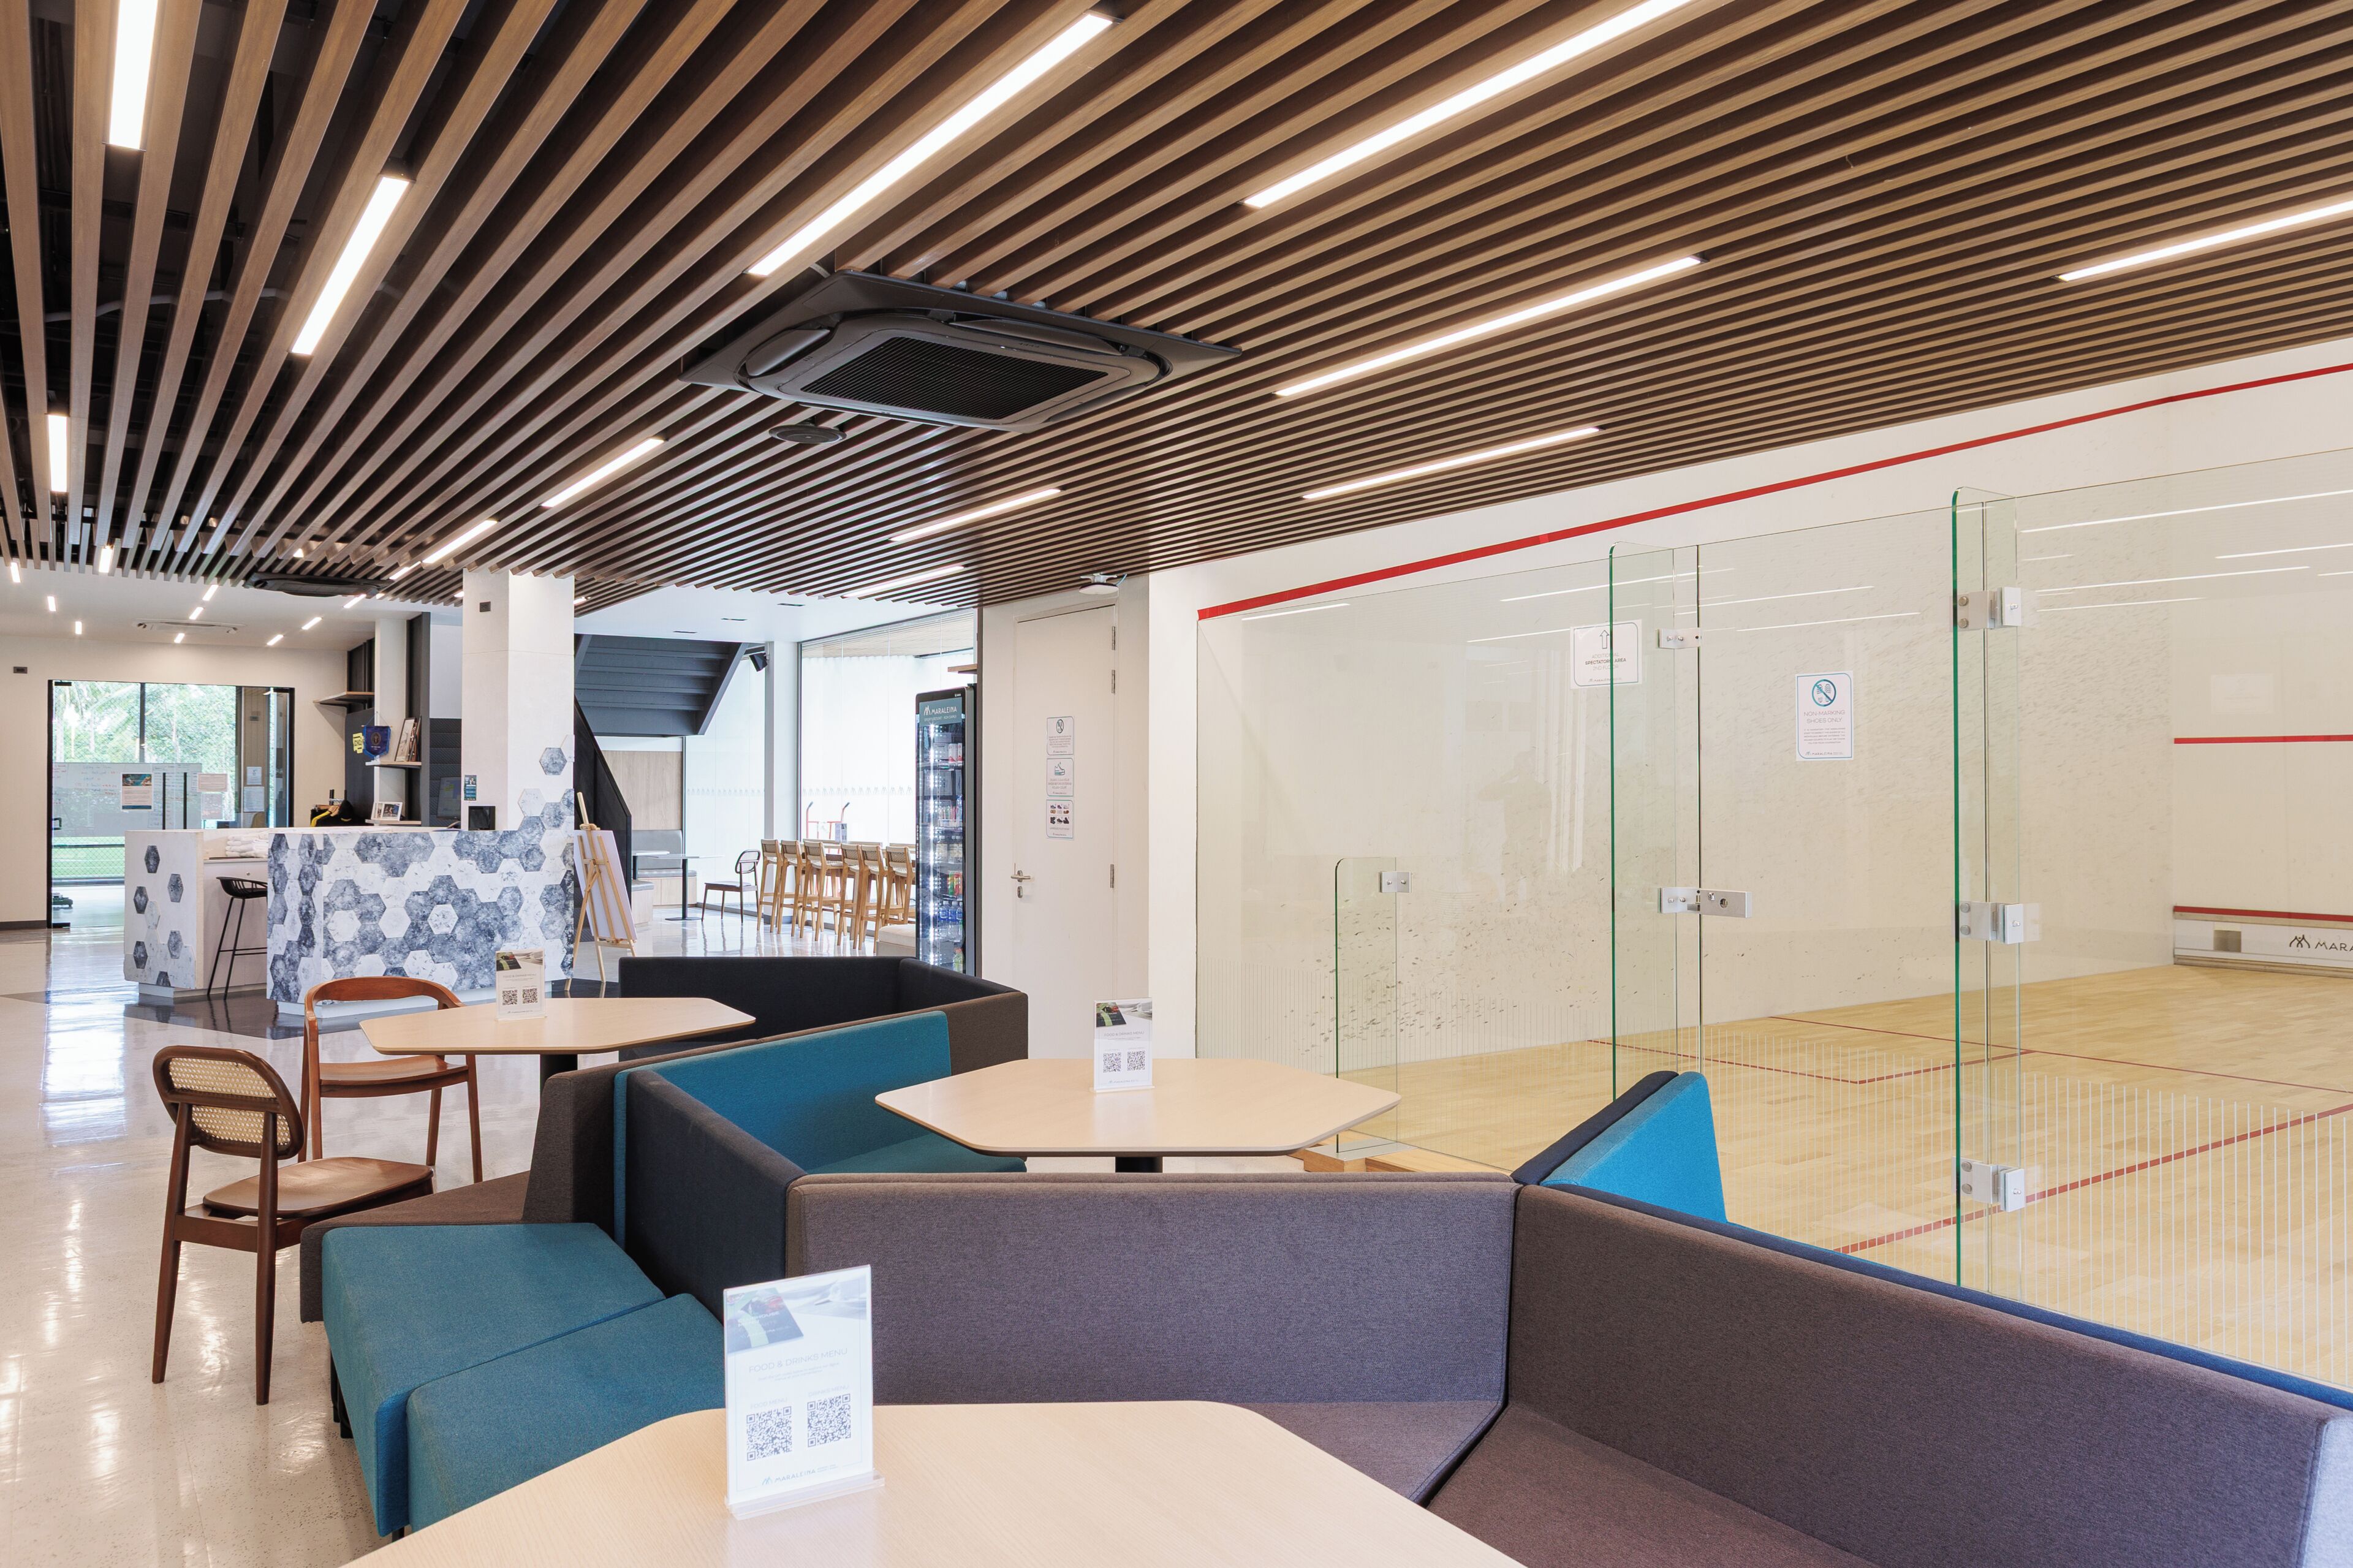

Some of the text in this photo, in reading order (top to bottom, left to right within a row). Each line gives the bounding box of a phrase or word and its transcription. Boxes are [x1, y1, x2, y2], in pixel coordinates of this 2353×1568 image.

[931, 706, 957, 715] MARALEINA
[749, 1362, 775, 1373] FOOD
[786, 1354, 819, 1366] DRINKS
[821, 1347, 847, 1358] MENU
[774, 1468, 816, 1483] MARALEINA
